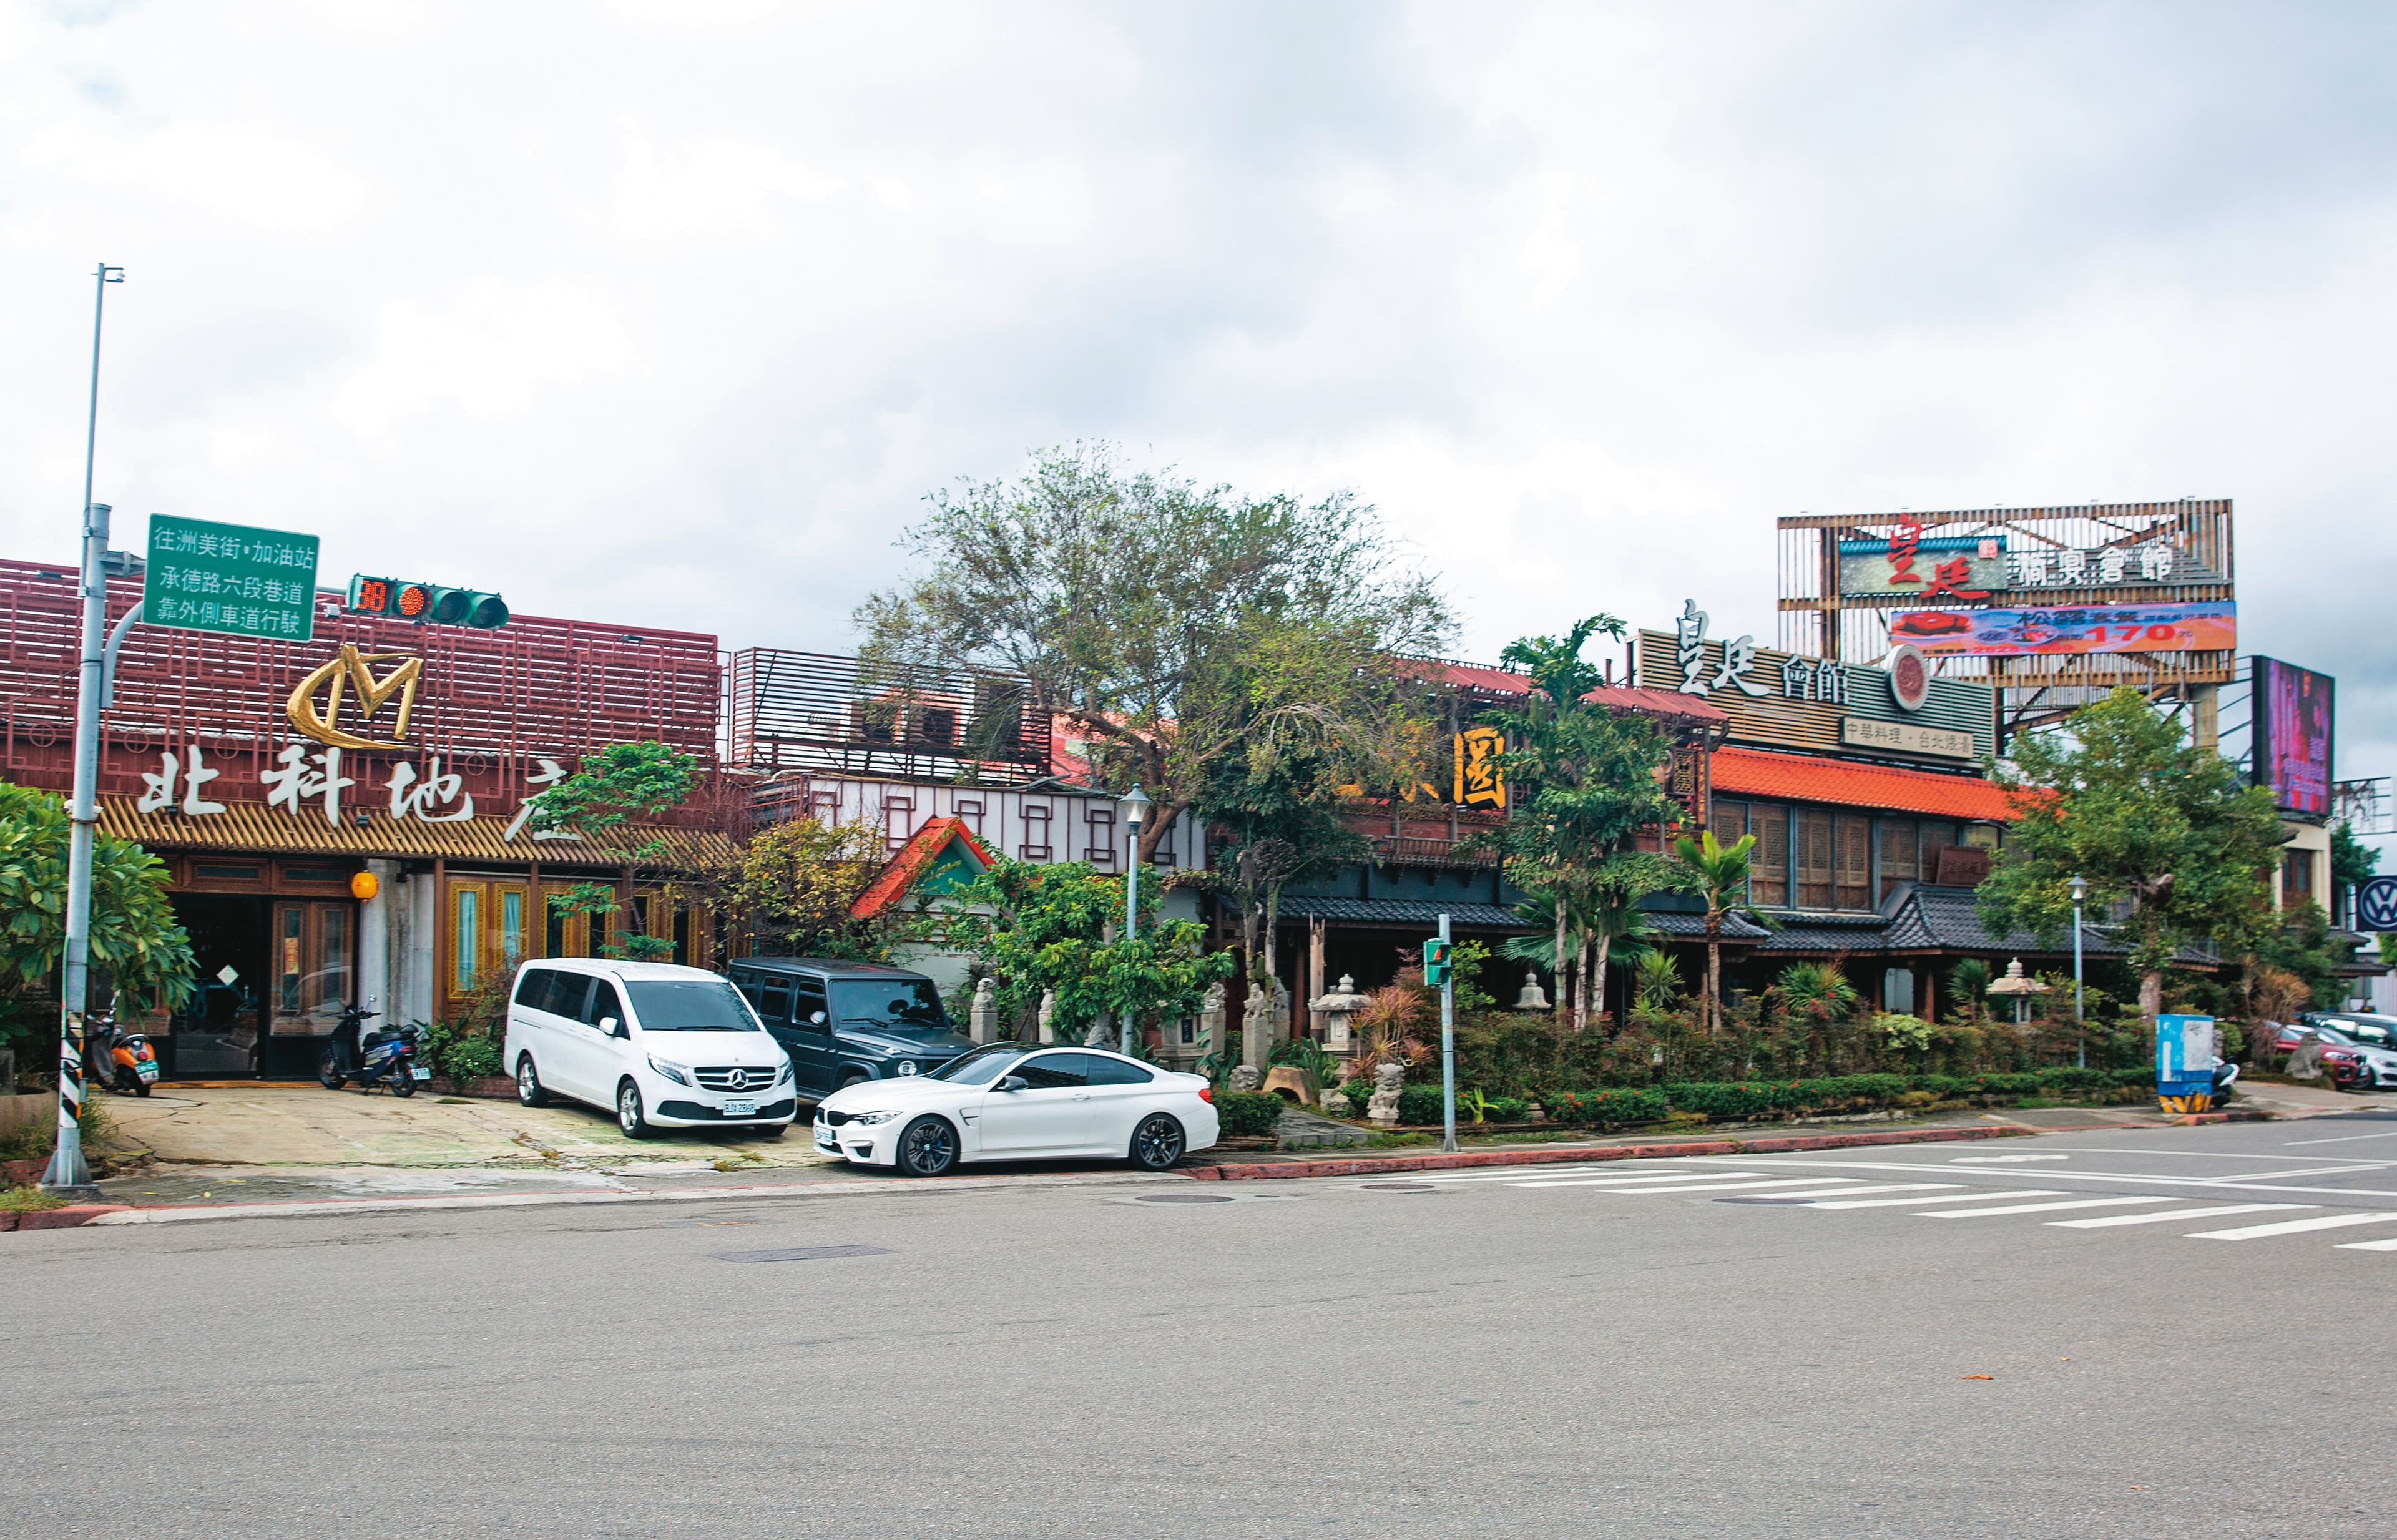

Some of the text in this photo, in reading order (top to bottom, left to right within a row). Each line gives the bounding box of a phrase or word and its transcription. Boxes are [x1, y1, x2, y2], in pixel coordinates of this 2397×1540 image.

[160, 566, 303, 604] 承德路六段巷道
[157, 596, 300, 634] 靠外側車道行駛
[1780, 654, 1850, 704] 會館
